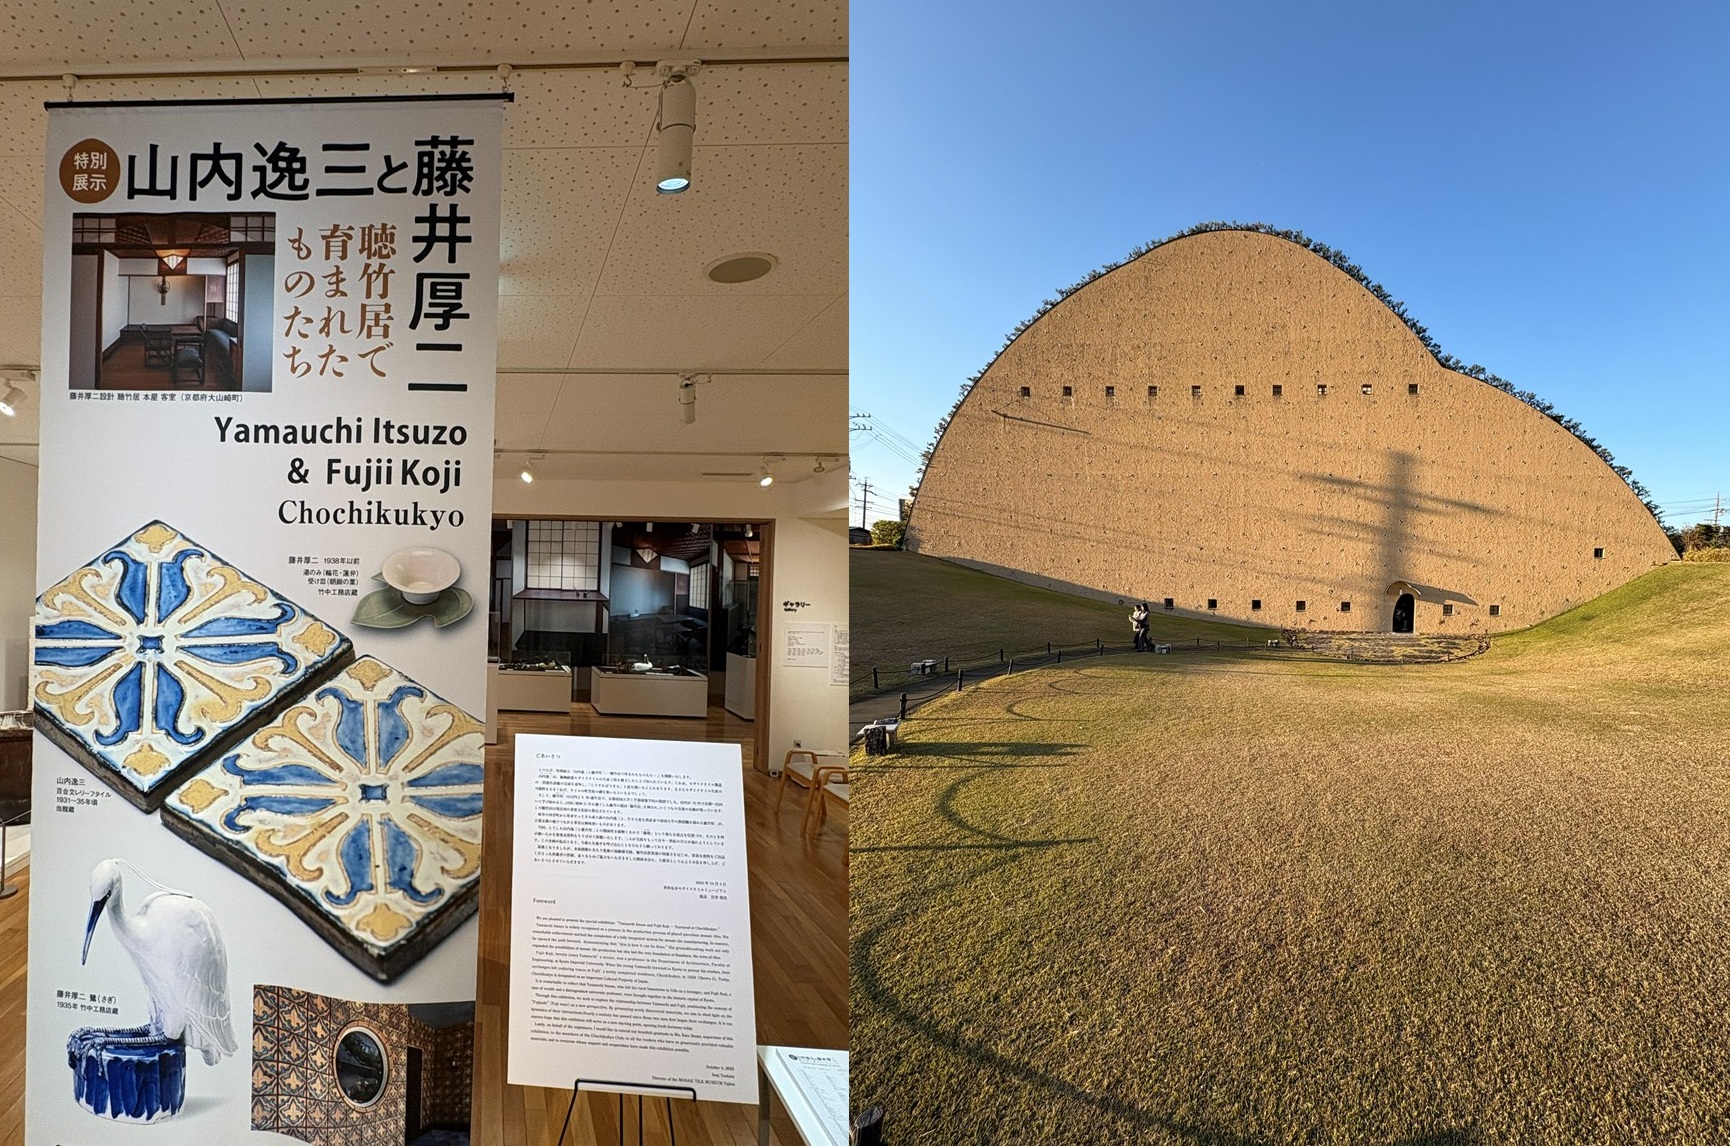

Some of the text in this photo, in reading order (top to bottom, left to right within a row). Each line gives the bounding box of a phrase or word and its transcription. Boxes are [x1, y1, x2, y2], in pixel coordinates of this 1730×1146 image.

[73, 152, 108, 170] 特別
[72, 173, 107, 192] 展示
[281, 225, 316, 380] ものたち
[318, 222, 355, 378] 育まれた
[356, 222, 398, 379] 聴竹居で
[214, 416, 468, 445] Yamauchi Itsuzo
[287, 457, 461, 494] & Fujii Koji
[278, 500, 465, 531] Chochikukyo
[783, 600, 811, 608] ギャラリー
